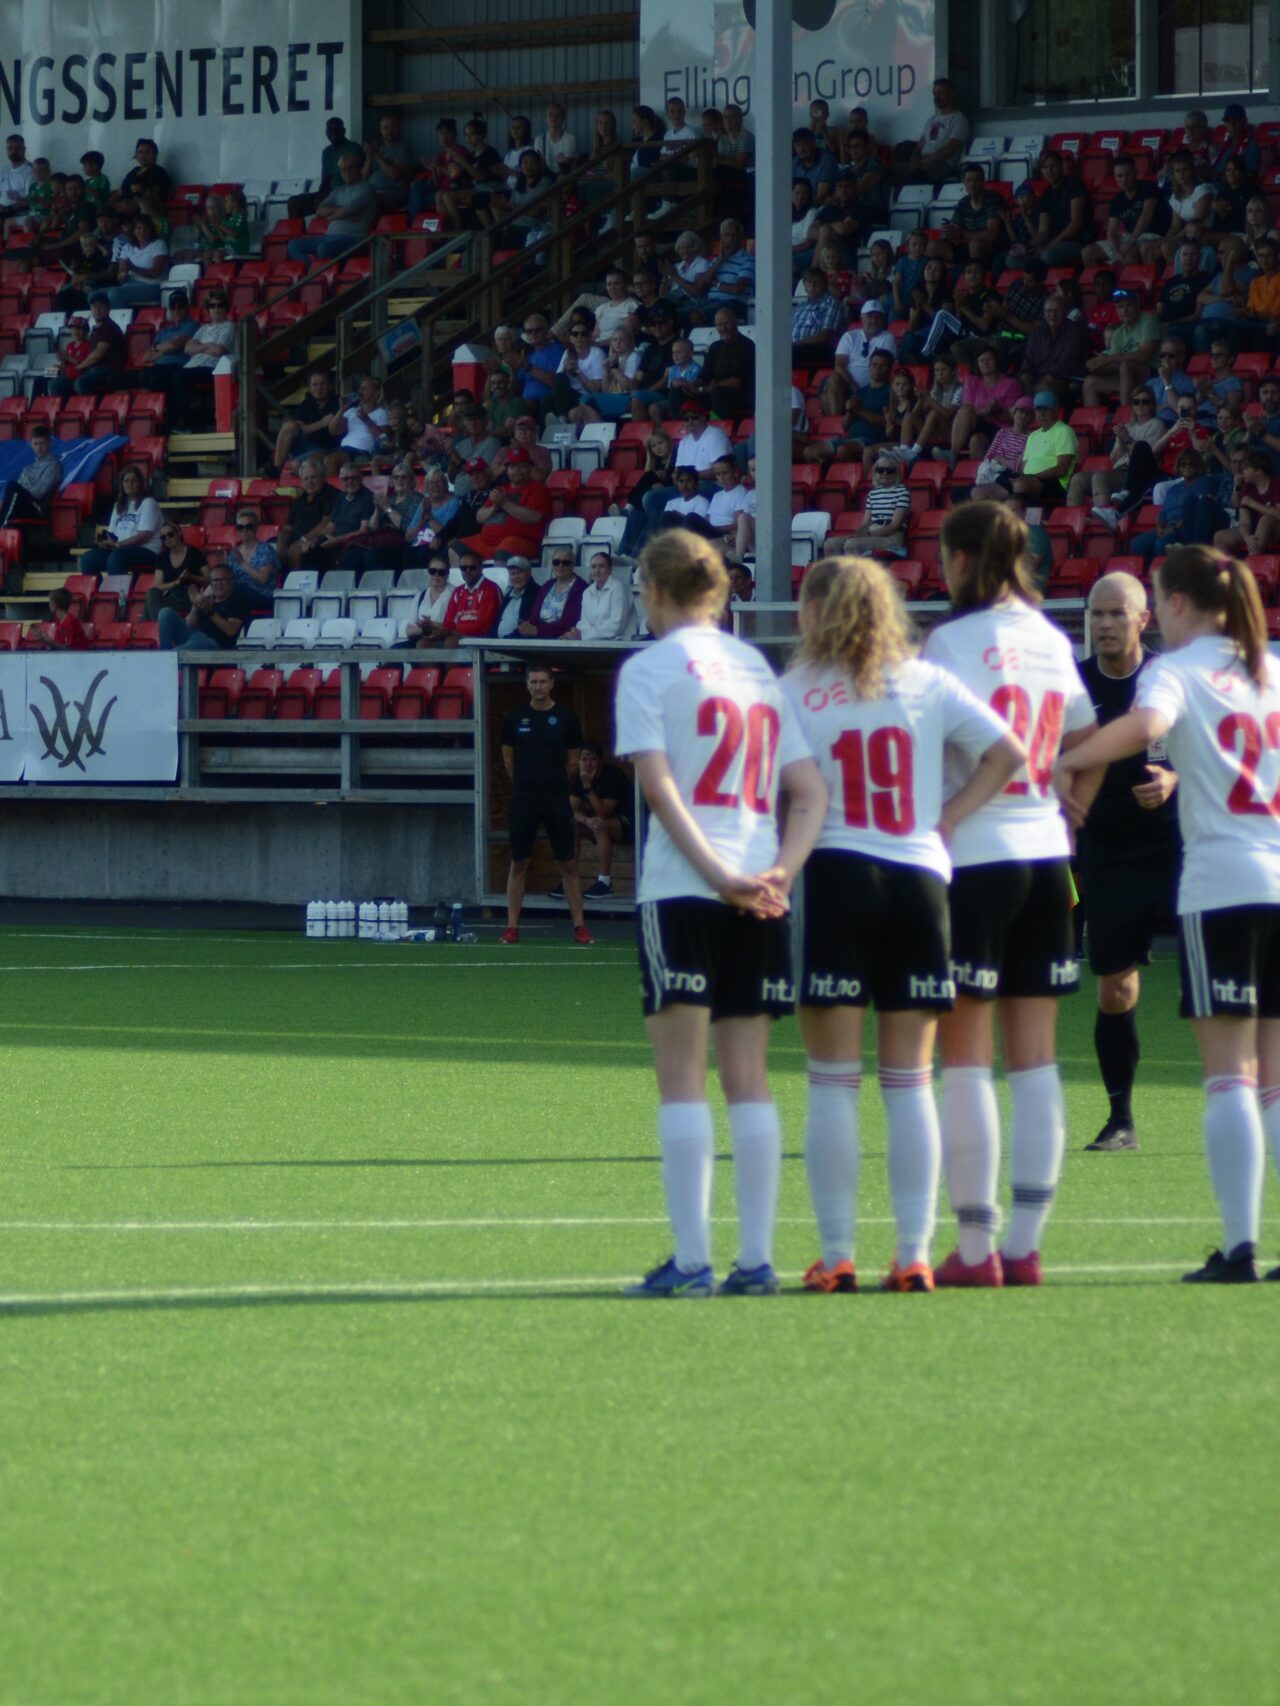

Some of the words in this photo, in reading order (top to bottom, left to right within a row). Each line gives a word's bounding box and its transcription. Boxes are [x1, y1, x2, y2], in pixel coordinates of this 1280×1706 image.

[663, 59, 916, 117] EllingnGroup
[693, 696, 780, 815] 20
[831, 726, 916, 836] 19
[910, 974, 957, 999] ht.n
